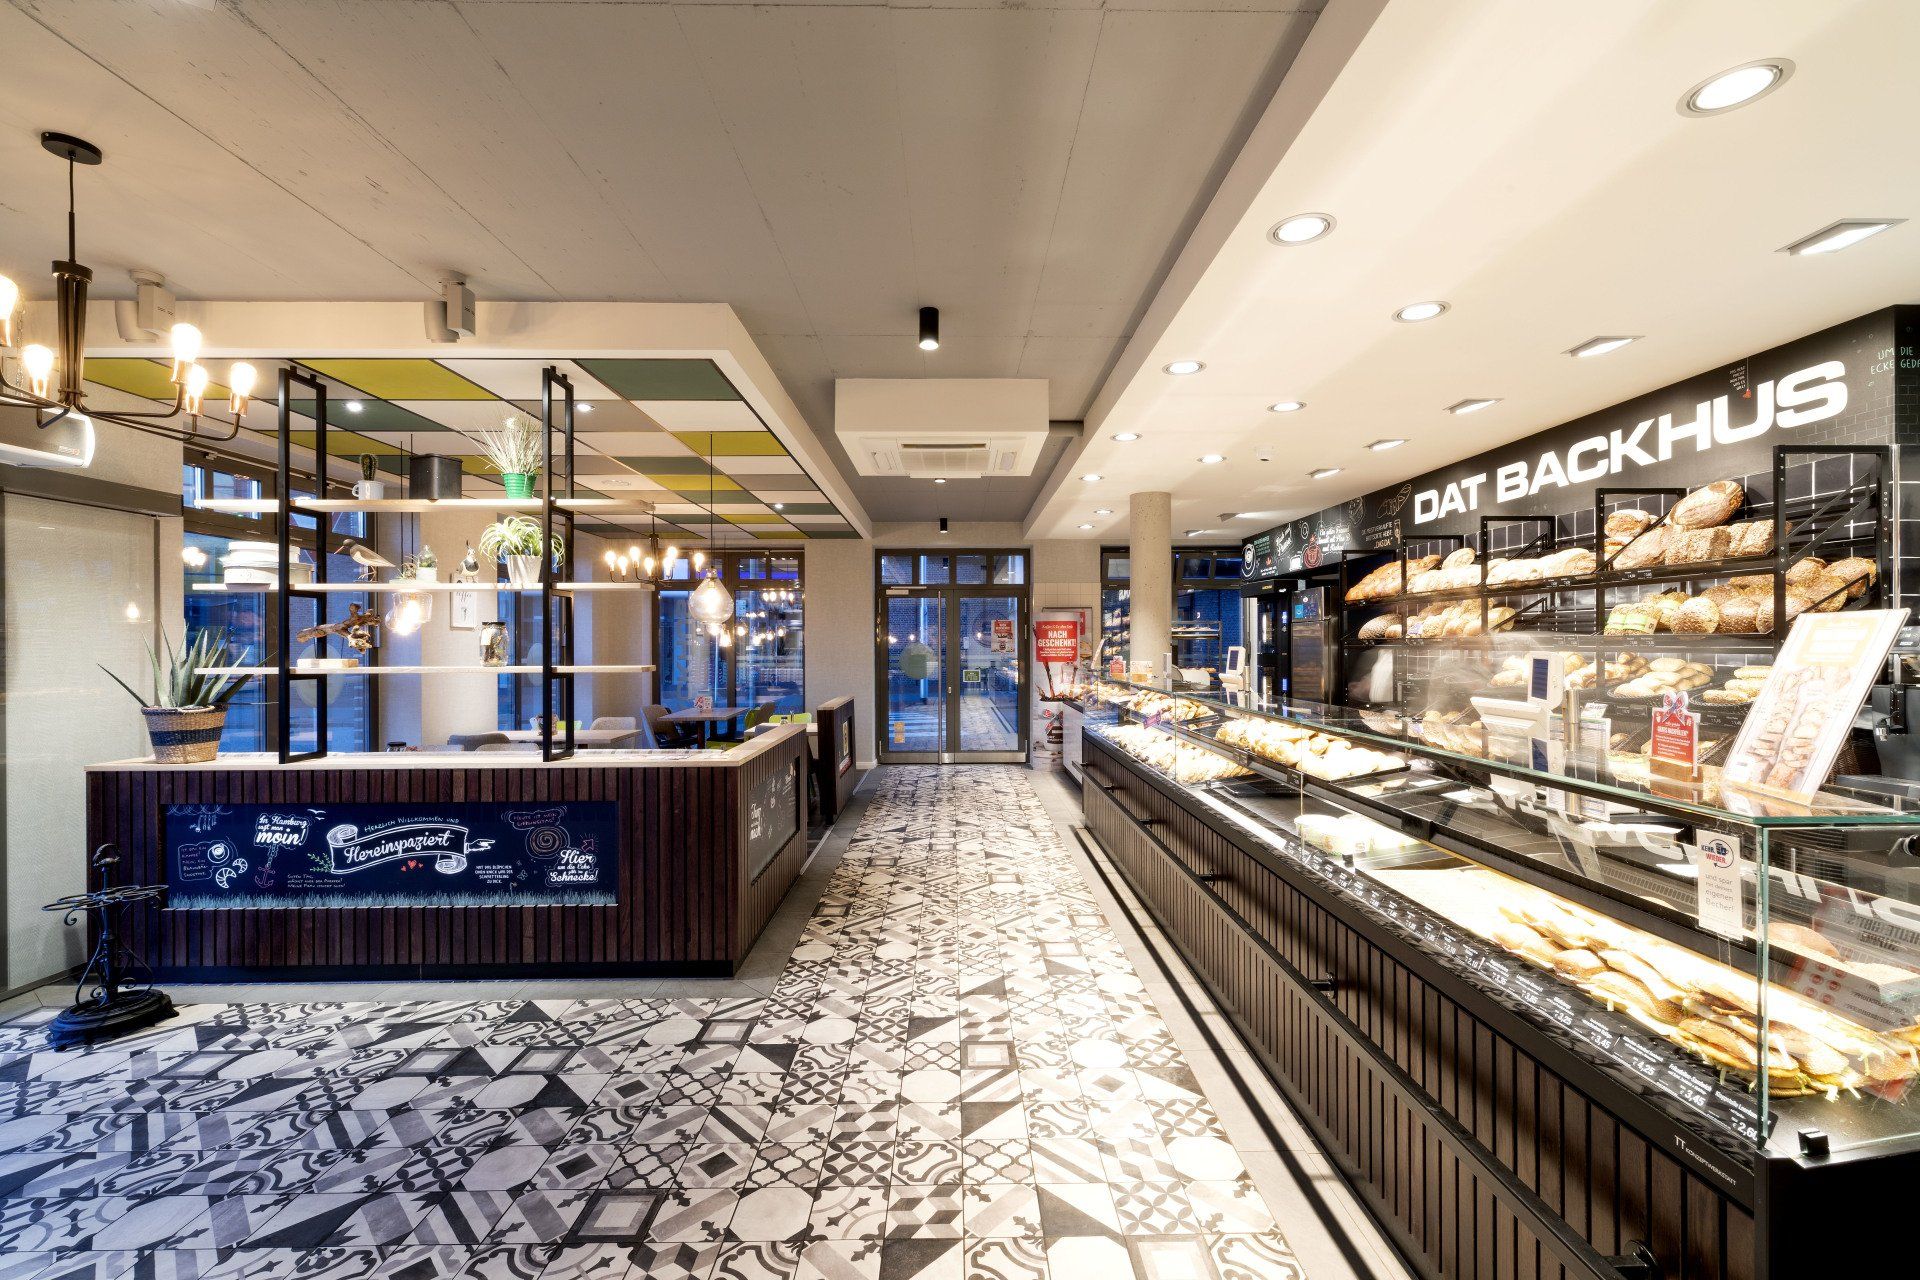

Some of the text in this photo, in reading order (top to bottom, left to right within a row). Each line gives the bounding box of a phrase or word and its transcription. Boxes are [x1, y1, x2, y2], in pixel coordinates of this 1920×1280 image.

[1878, 346, 1914, 360] UM DIE
[1870, 360, 1895, 375] ECKE
[1414, 360, 1849, 525] DAT BACKHUS
[1047, 630, 1068, 639] NACH
[1037, 638, 1077, 647] GESCHENKT!
[257, 824, 270, 832] sagt
[271, 815, 308, 829] Hamburg
[364, 820, 396, 833] HERZLICH
[398, 815, 443, 824] WILLKOMMEN
[256, 828, 307, 846] moin!
[343, 830, 455, 864] Hereinspaziert
[560, 850, 594, 864] Hier
[549, 870, 599, 882] Schnecke!
[1705, 873, 1734, 886] und spar
[1715, 884, 1733, 893] deinem
[1705, 889, 1734, 903] eigenen
[1705, 897, 1735, 912] Becher!
[1558, 1012, 1574, 1027] 3,25
[1594, 1035, 1612, 1050] 3,45
[1637, 1061, 1656, 1076] 4,25
[1684, 1089, 1706, 1107] 3,45
